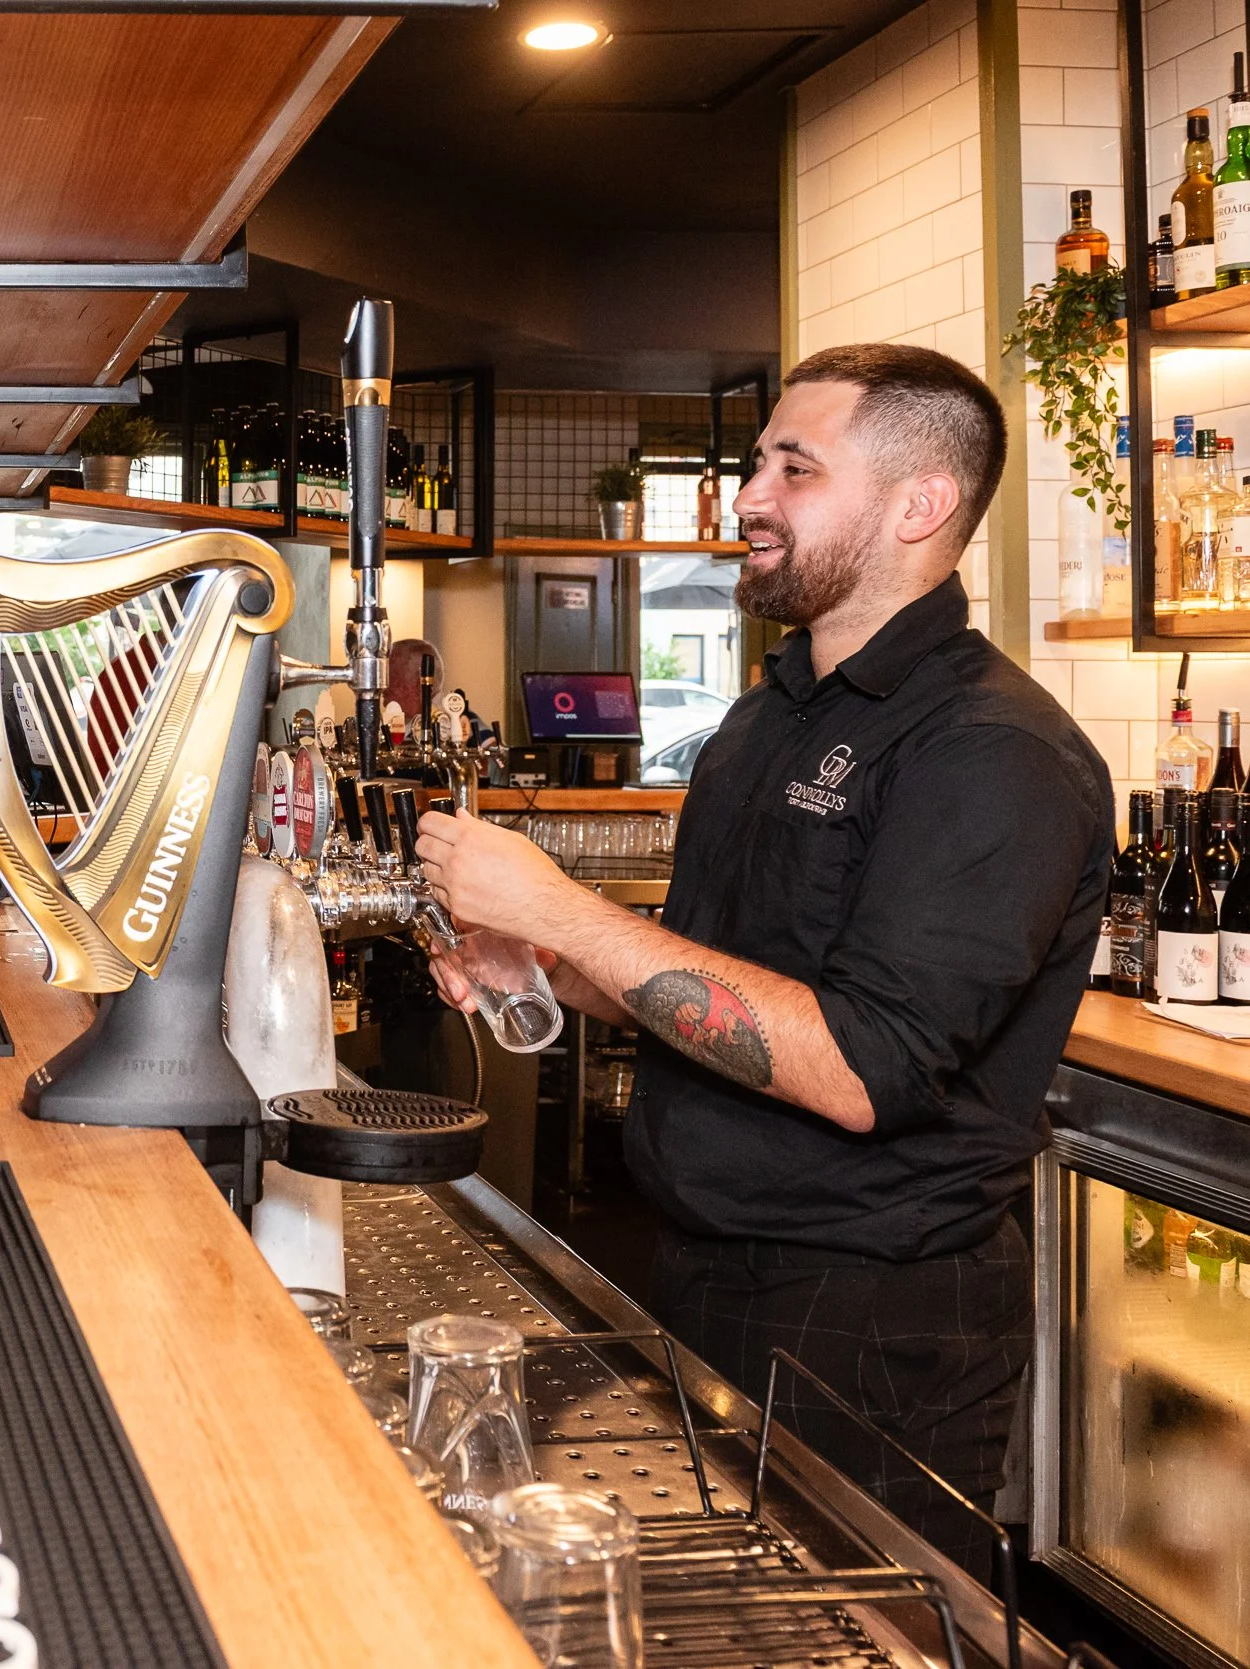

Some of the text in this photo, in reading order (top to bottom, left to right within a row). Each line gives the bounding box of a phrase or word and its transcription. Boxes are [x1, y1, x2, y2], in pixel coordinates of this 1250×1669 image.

[323, 726, 333, 734] IPA
[317, 777, 326, 810] BREWERY
[785, 781, 846, 811] CONNOLLYS
[122, 771, 210, 942] GUINNESS
